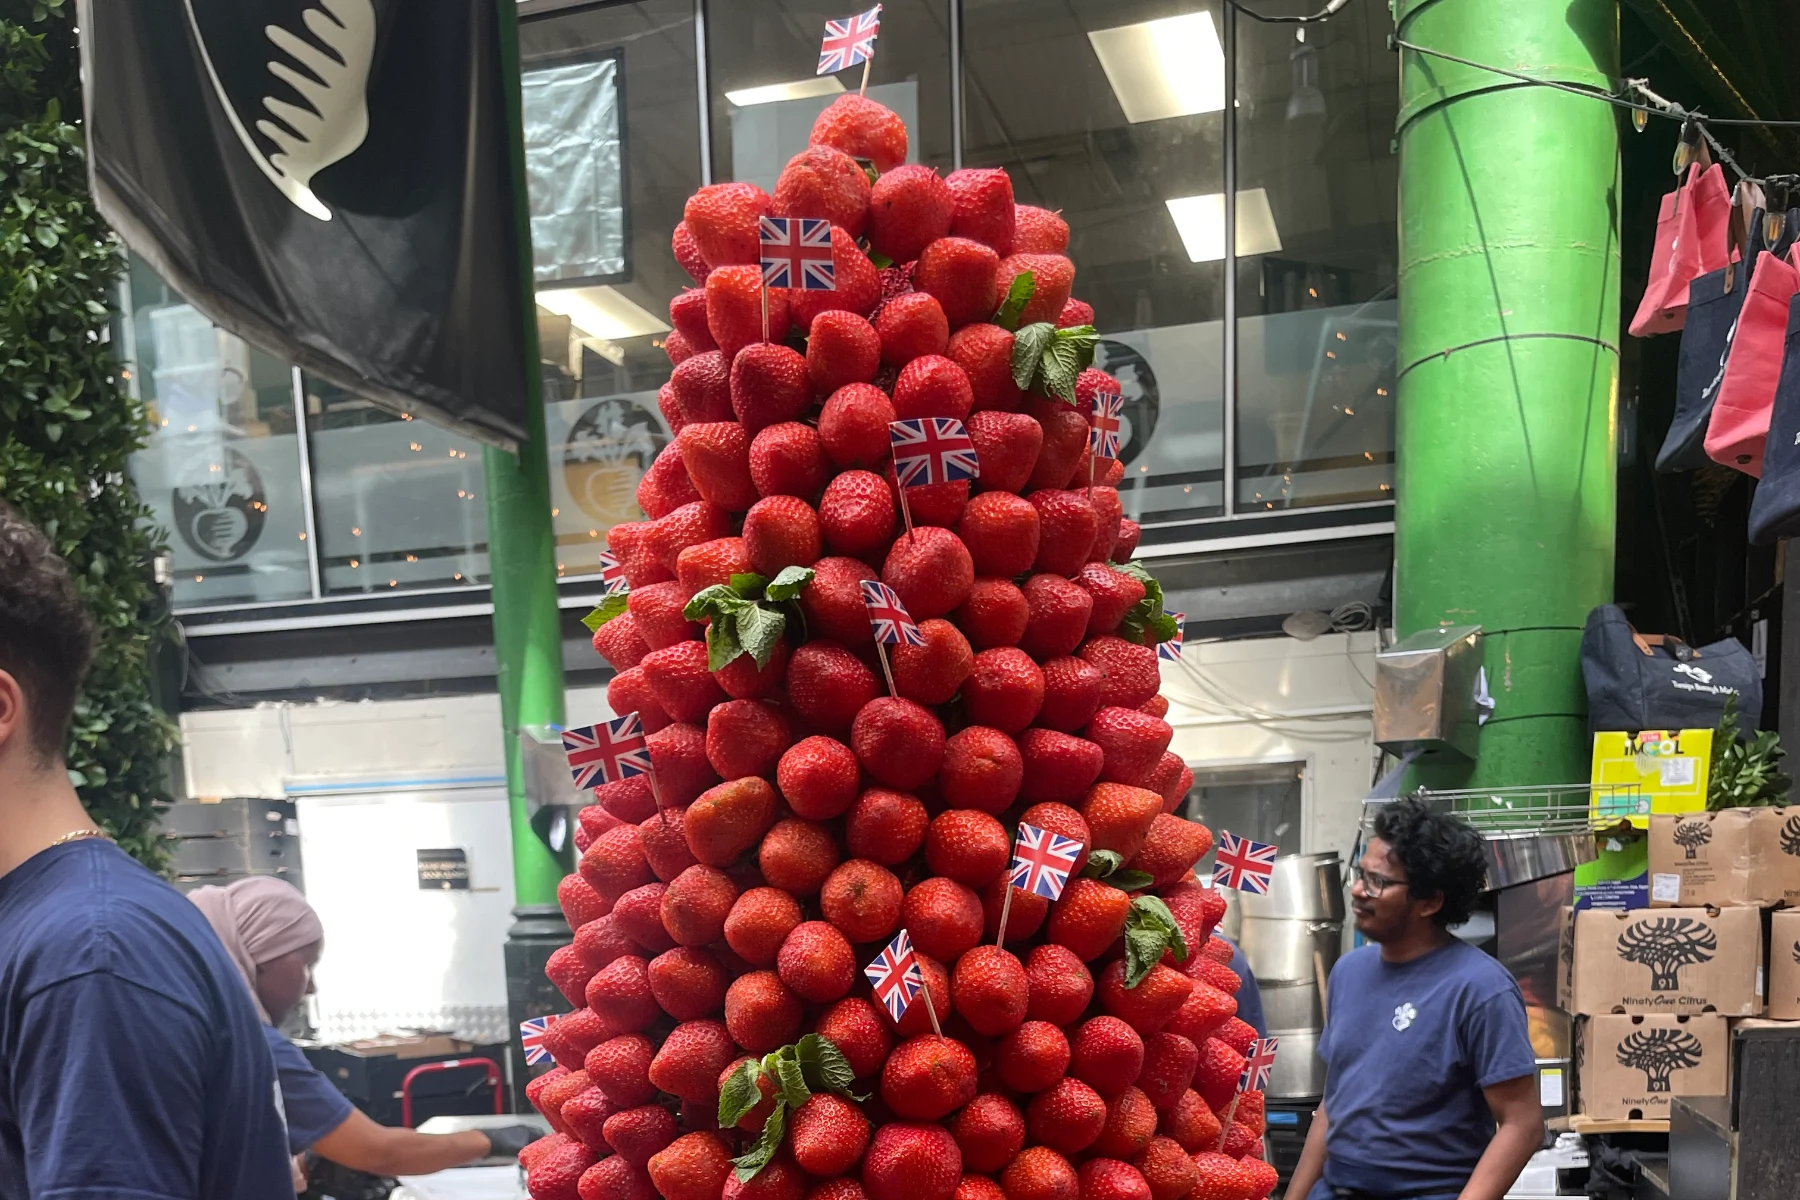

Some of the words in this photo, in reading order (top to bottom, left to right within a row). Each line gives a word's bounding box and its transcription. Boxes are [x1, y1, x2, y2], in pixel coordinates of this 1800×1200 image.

[1658, 978, 1674, 989] 91
[1622, 994, 1676, 1007] NinetyOne
[1678, 996, 1707, 1006] Citrus
[1652, 1081, 1666, 1092] 91
[1622, 1095, 1668, 1106] NinetyOne
